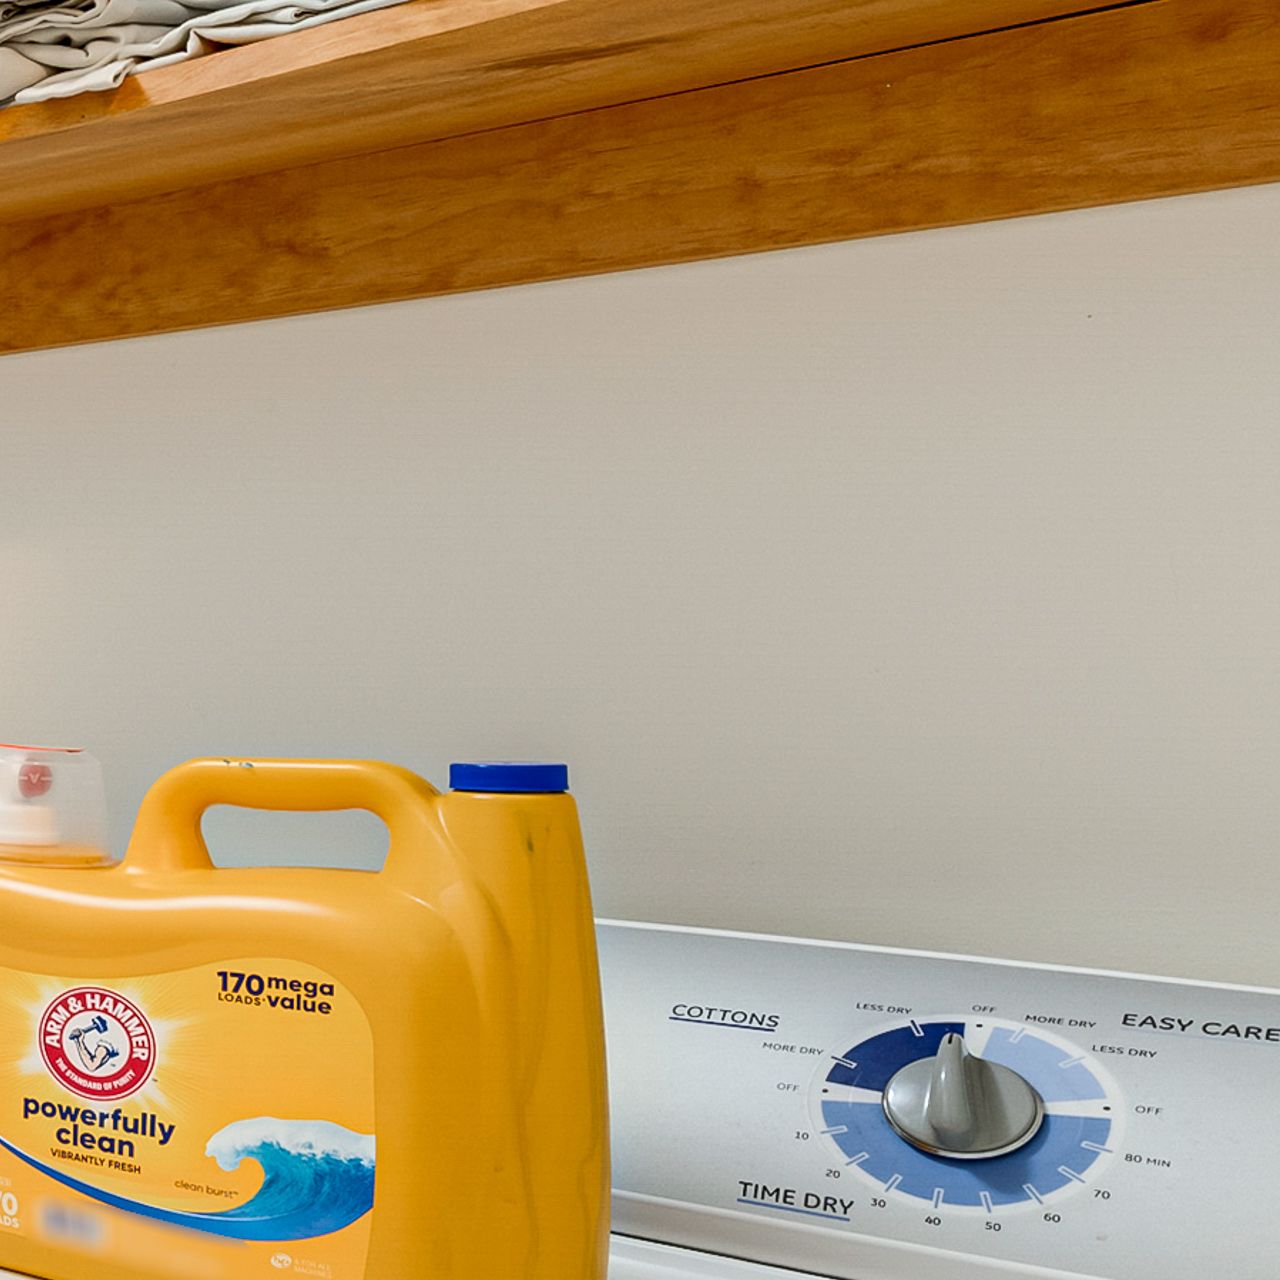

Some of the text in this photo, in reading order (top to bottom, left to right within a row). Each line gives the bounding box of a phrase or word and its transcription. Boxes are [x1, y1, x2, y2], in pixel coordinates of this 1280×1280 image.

[217, 970, 335, 998] 170 mega
[266, 994, 332, 1014] value
[856, 1002, 913, 1015] LESS DRY
[972, 1004, 997, 1014] OFF
[672, 1003, 780, 1028] COTTONS
[1025, 1014, 1097, 1029] MORE DRY
[45, 993, 150, 1061] ARM & HAMMER
[1121, 1013, 1280, 1042] EASY CARE
[762, 1041, 824, 1055] MORE DRY
[1092, 1044, 1158, 1058] LESS DRY
[66, 1070, 103, 1091] STANDARD
[103, 1081, 114, 1091] OF
[113, 1069, 136, 1090] PURITY
[776, 1082, 800, 1092] OFF
[1135, 1105, 1163, 1115] OFF
[23, 1096, 176, 1145] powerfully
[56, 1124, 134, 1158] clean
[795, 1131, 809, 1140] 10
[50, 1148, 142, 1174] VIBRANTLY FRESH
[1124, 1153, 1172, 1168] 80 MIN
[825, 1169, 841, 1179] 20
[174, 1179, 204, 1193] clean
[739, 1180, 854, 1215] TIME DRY
[1094, 1189, 1111, 1200] 70
[870, 1198, 887, 1208] 30
[924, 1216, 942, 1226] 40
[1043, 1213, 1061, 1223] 60
[985, 1221, 1001, 1232] 50
